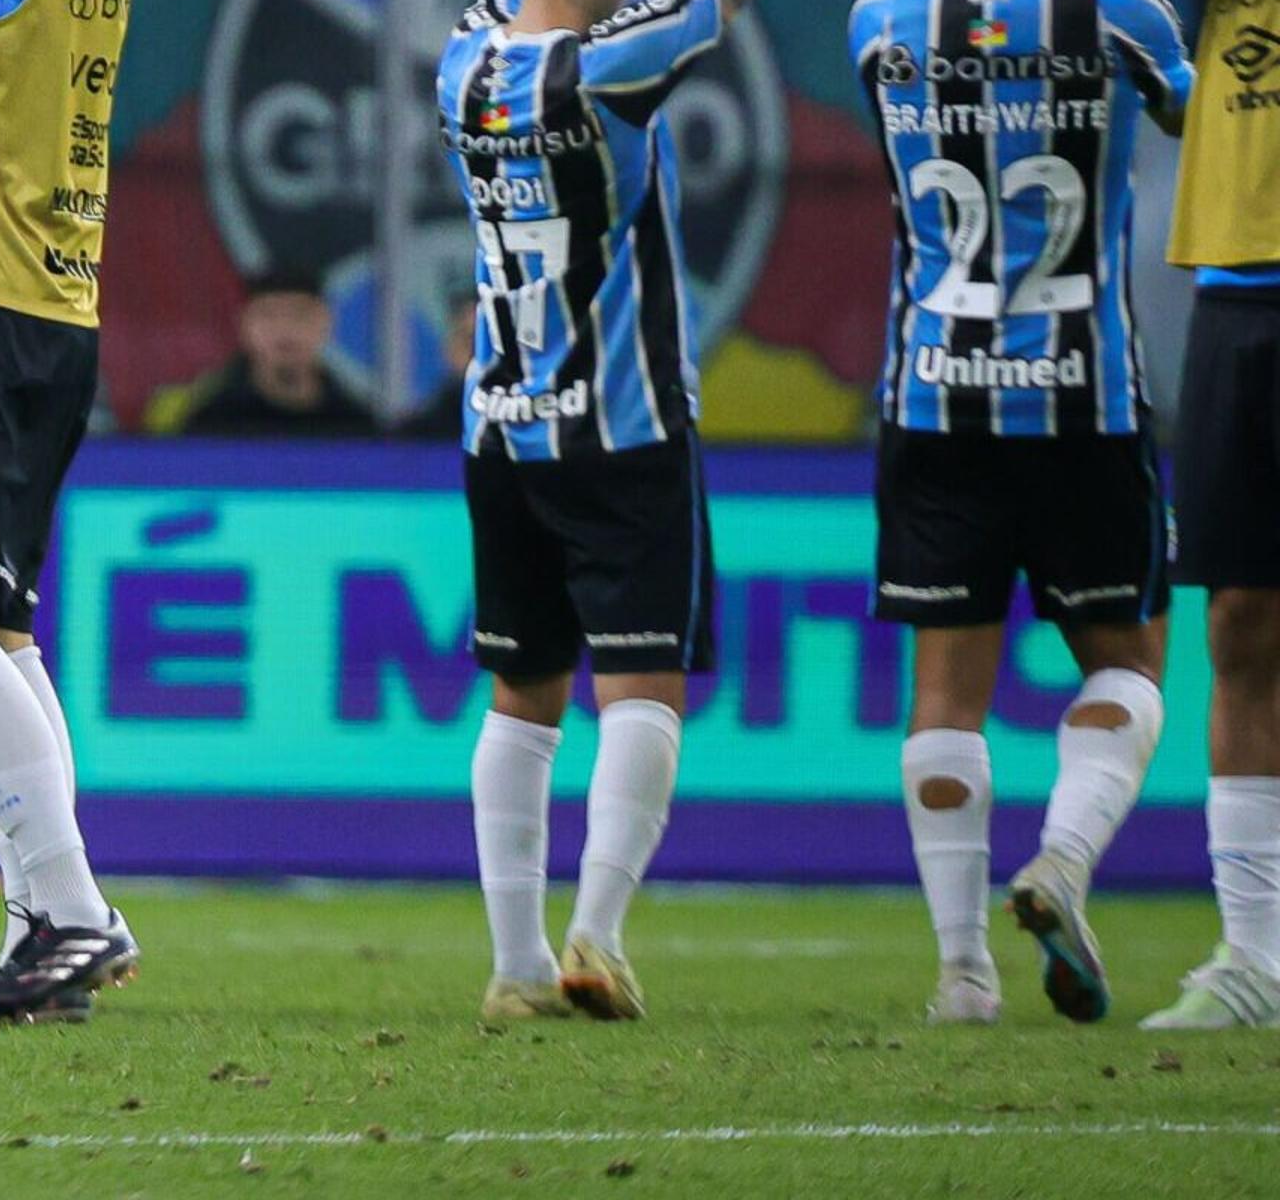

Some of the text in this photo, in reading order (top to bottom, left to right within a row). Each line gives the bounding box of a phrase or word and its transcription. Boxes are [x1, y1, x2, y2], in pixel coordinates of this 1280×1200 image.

[884, 99, 1110, 135] BRAITHWAITE
[471, 175, 546, 207] DODI
[908, 154, 1094, 320] 22
[915, 345, 1087, 388] Unimed
[103, 507, 254, 722] É
